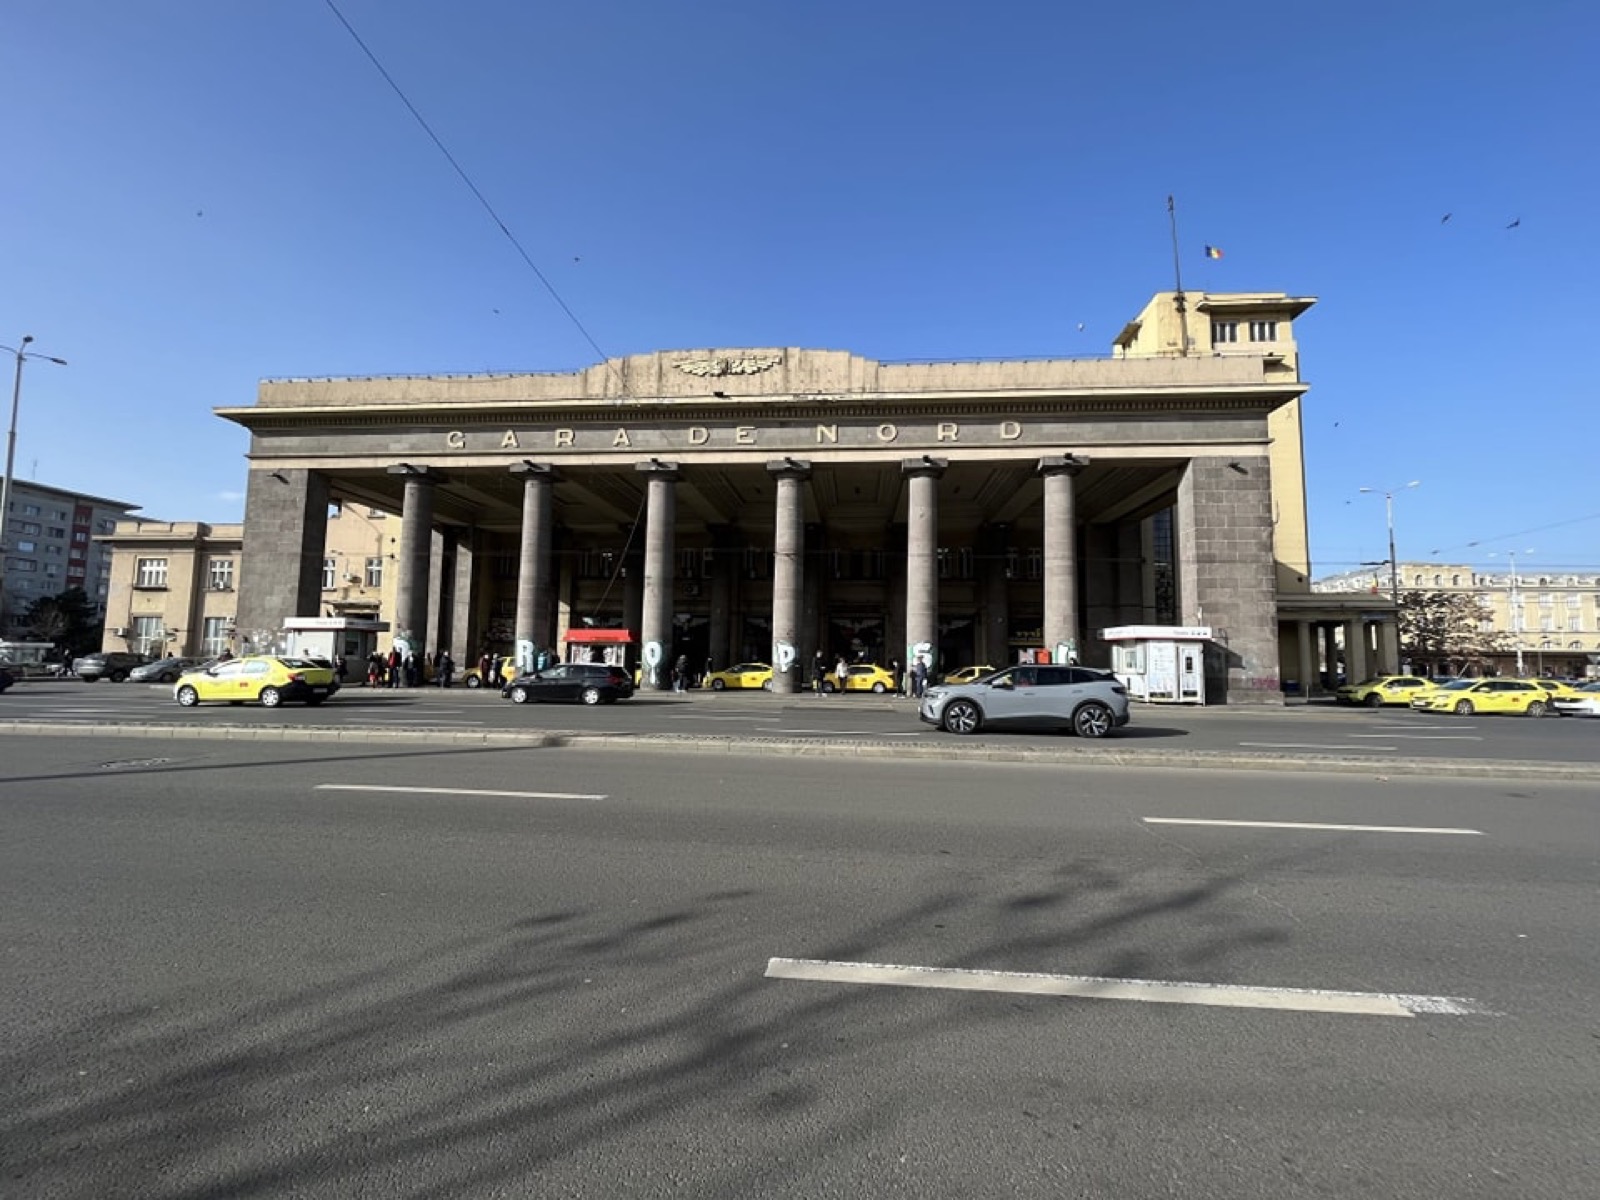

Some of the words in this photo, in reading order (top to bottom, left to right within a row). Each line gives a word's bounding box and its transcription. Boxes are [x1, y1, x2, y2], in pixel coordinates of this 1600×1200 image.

[446, 428, 632, 449] GARA
[688, 425, 757, 446] DE
[815, 421, 1023, 444] NORD
